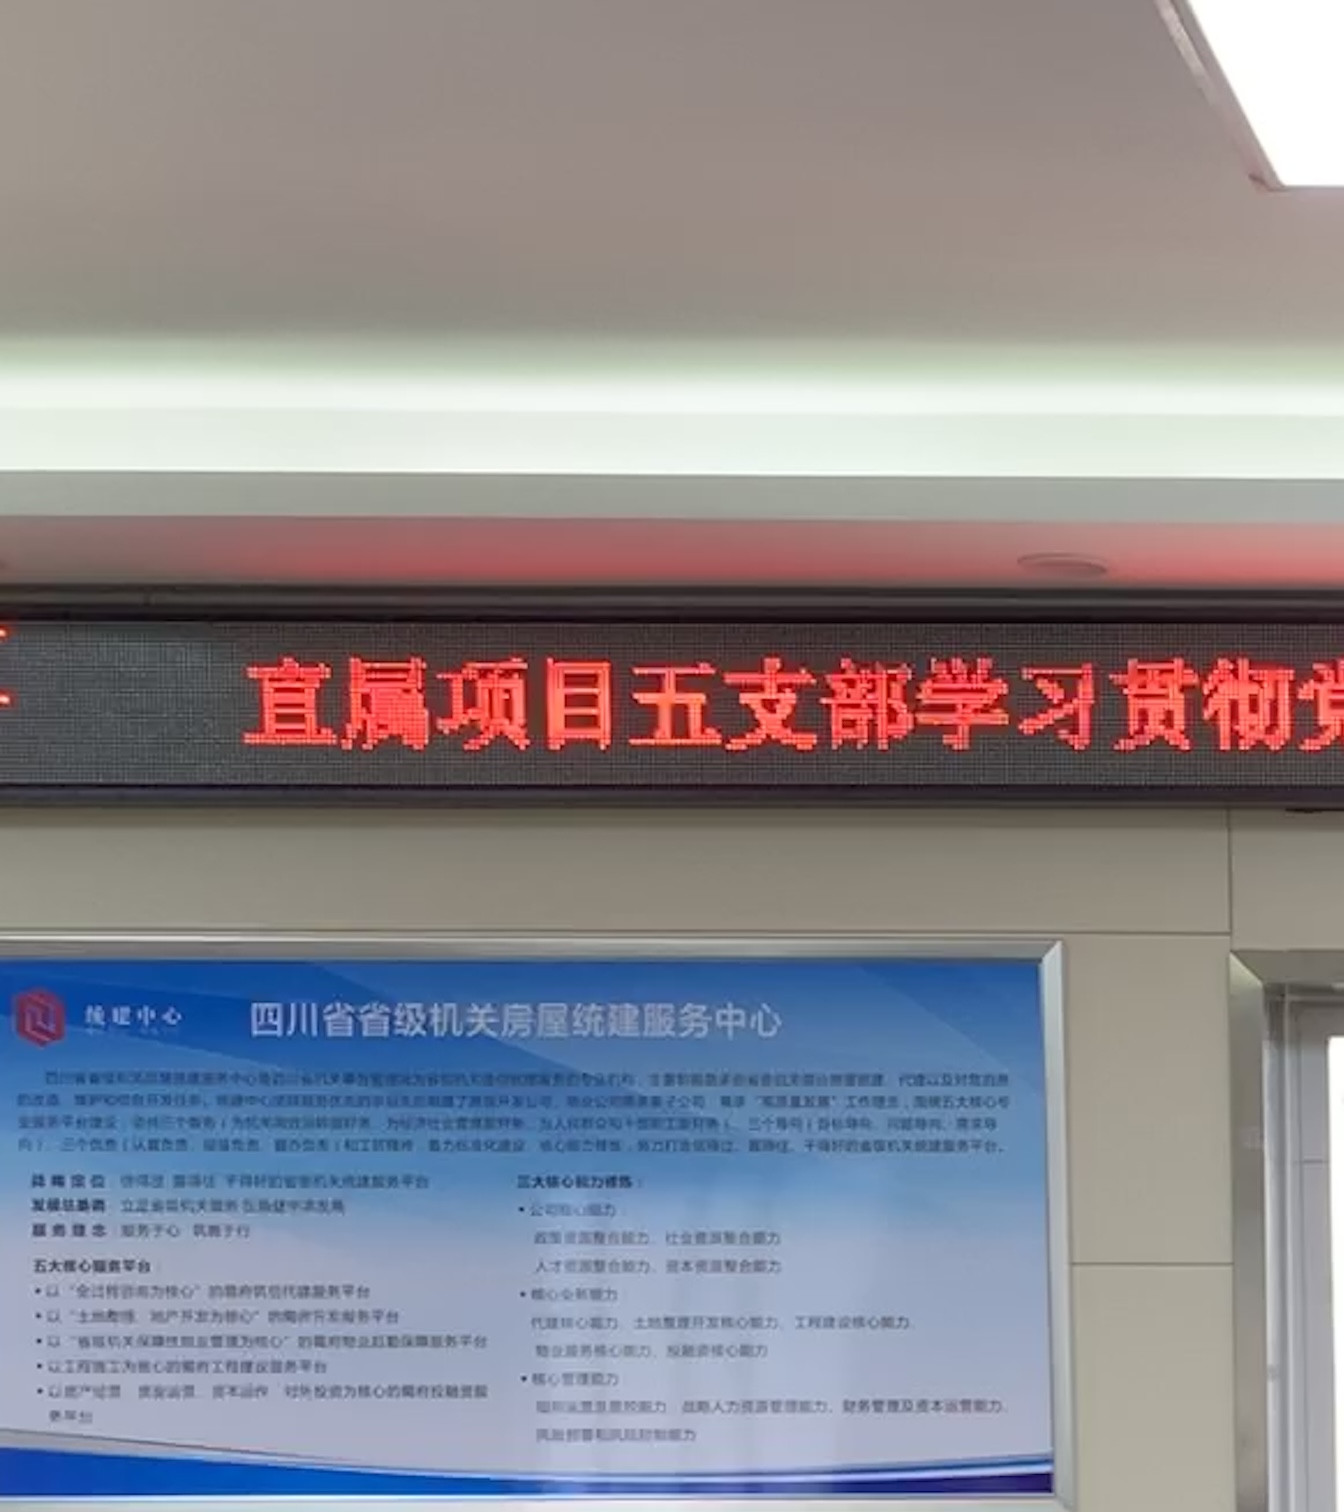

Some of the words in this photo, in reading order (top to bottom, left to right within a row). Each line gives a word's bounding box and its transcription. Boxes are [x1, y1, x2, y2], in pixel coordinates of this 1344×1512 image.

[250, 1001, 783, 1040] 四川省省级机关房屋统建服务中心
